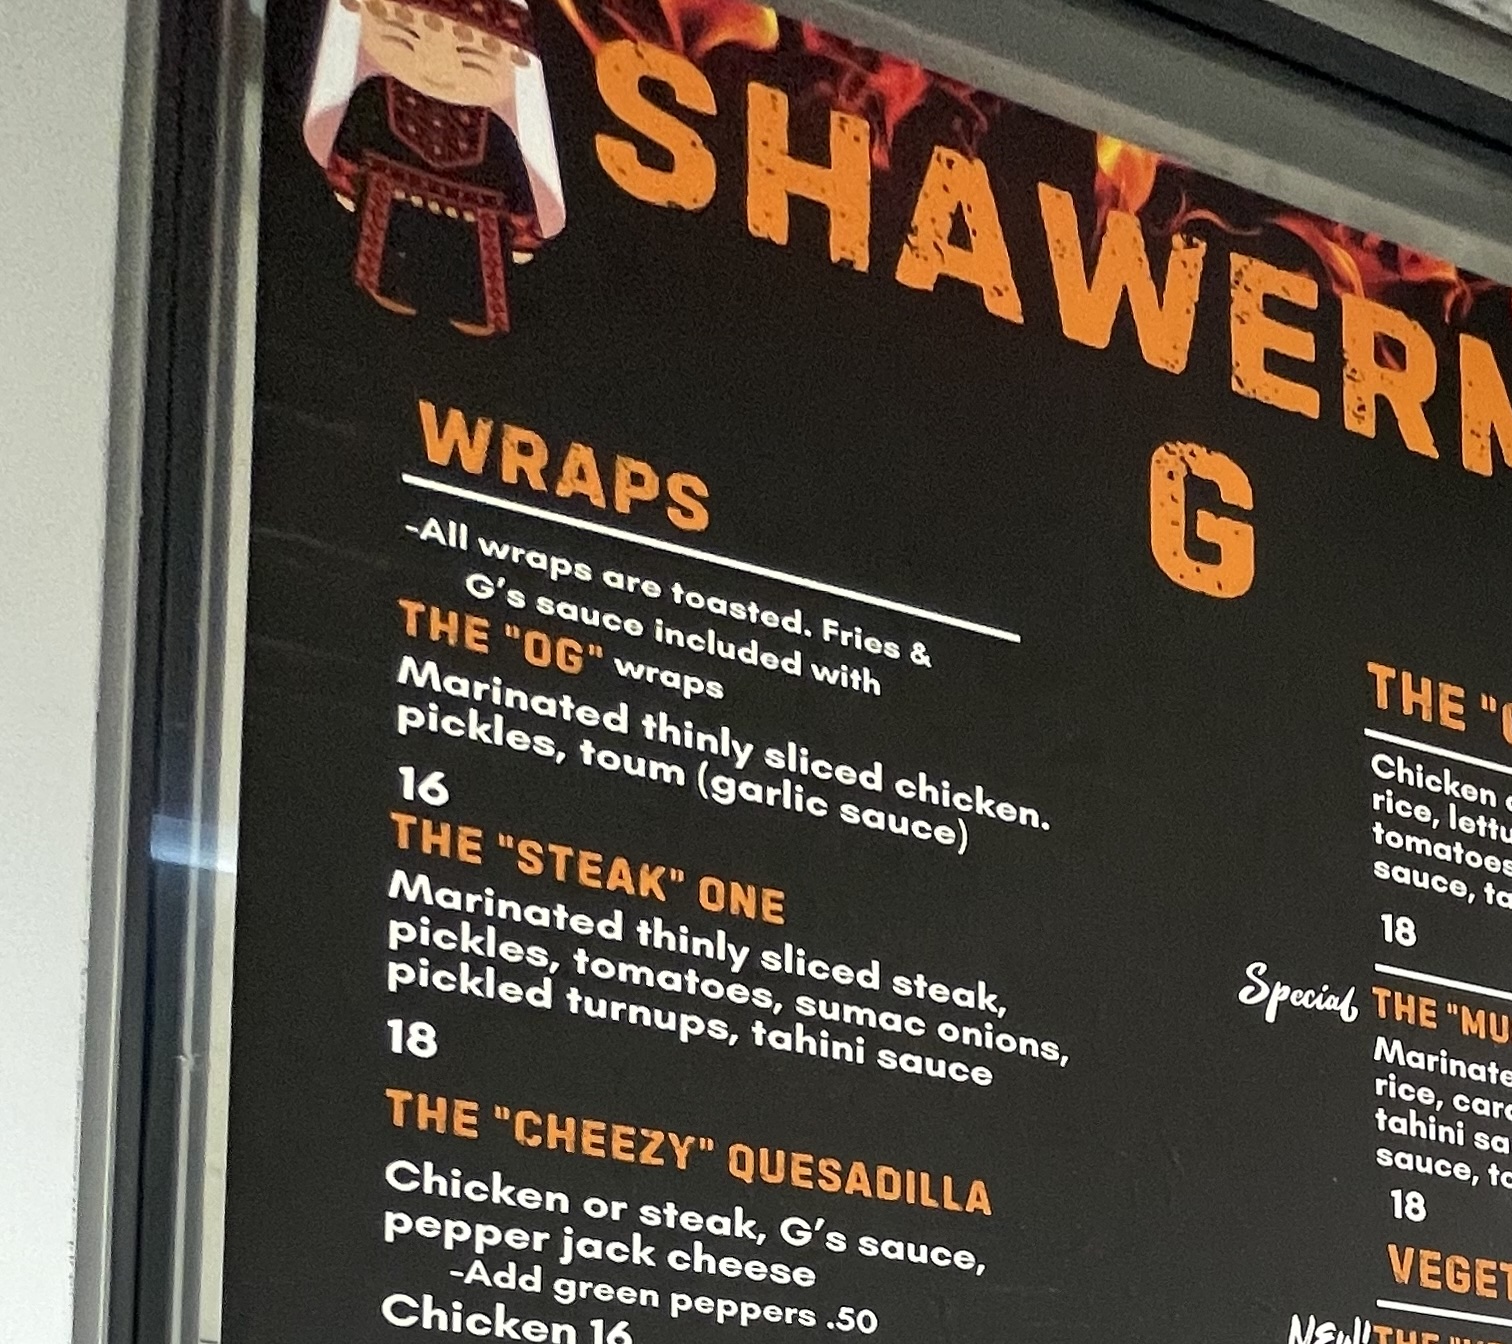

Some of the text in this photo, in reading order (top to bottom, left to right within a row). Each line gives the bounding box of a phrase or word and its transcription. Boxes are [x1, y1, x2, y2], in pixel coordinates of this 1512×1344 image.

[418, 398, 710, 532] WRAPS
[1148, 440, 1255, 600] G
[397, 598, 724, 700] THE "OG" wraps
[404, 517, 933, 668] -All wraps are toasted. Fries &
[1366, 661, 1466, 732] THE
[397, 702, 968, 856] pickles, toum (garlic sauce)
[389, 811, 785, 925] THE "STEAK" ONE
[387, 957, 993, 1086] pickled turnups, tahini sauce
[1238, 962, 1358, 1024] Special
[1371, 986, 1438, 1030] THE
[1374, 1107, 1465, 1147] tahini
[1375, 1072, 1444, 1112] rice,
[384, 1088, 992, 1216] THE "CHEEZY" QUESADILLA
